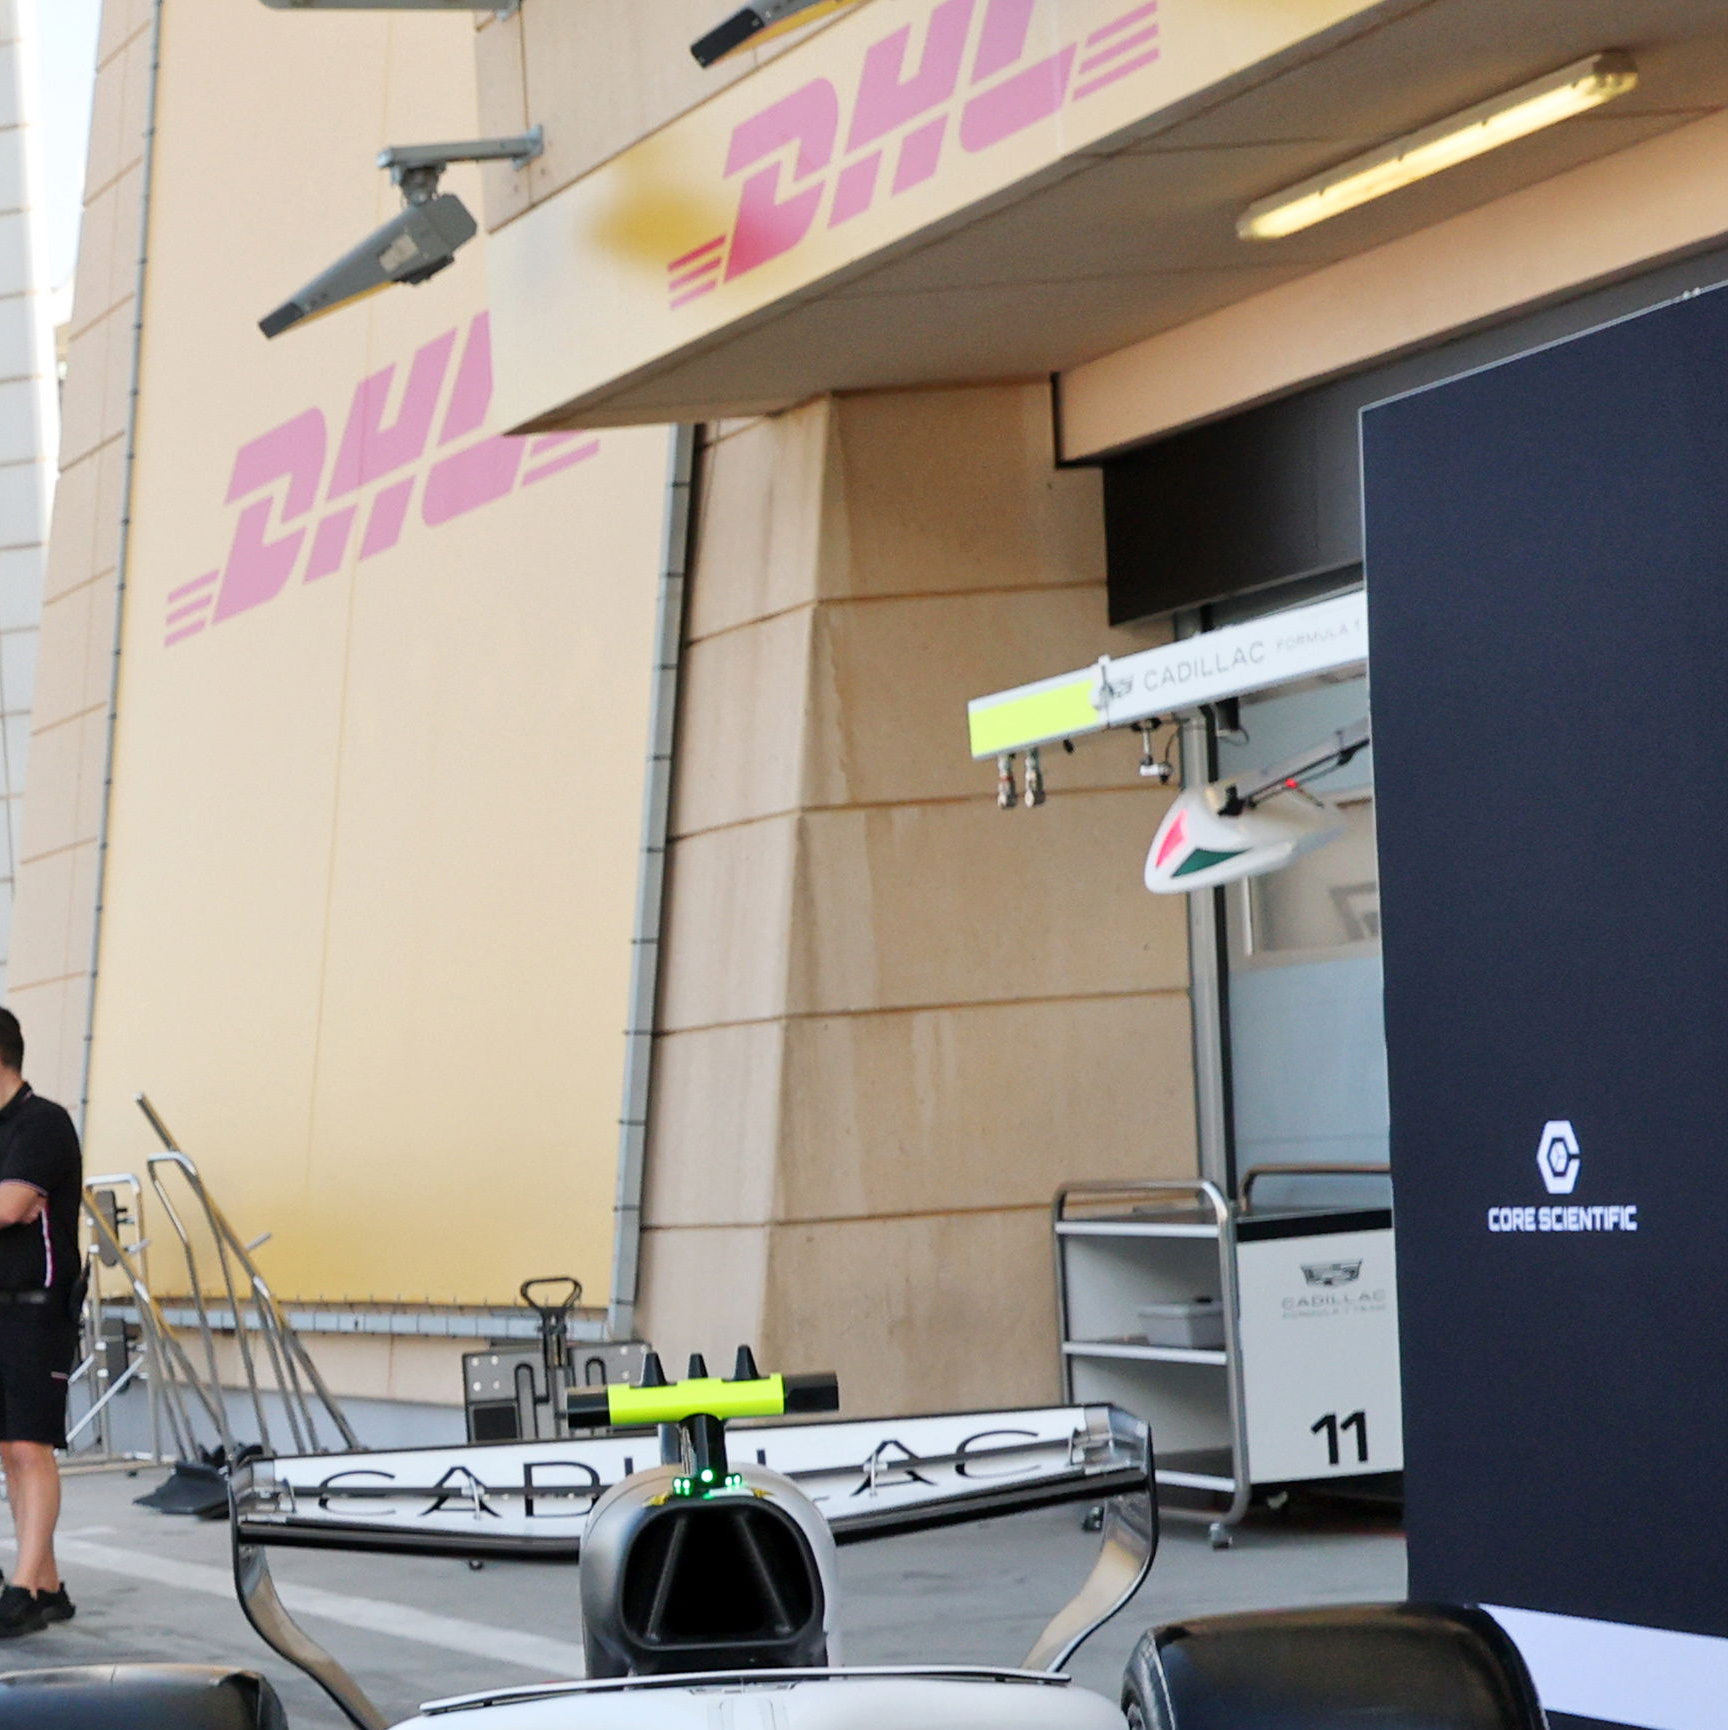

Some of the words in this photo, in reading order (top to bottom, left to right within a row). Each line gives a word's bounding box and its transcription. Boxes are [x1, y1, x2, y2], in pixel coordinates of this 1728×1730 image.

[724, 0, 1076, 284] DHL
[212, 311, 527, 624] DHL
[1143, 641, 1265, 693] CADILLAC
[1487, 1206, 1537, 1232] CORE
[1538, 1204, 1638, 1232] SCIENTIFIC
[1311, 1410, 1369, 1465] 11
